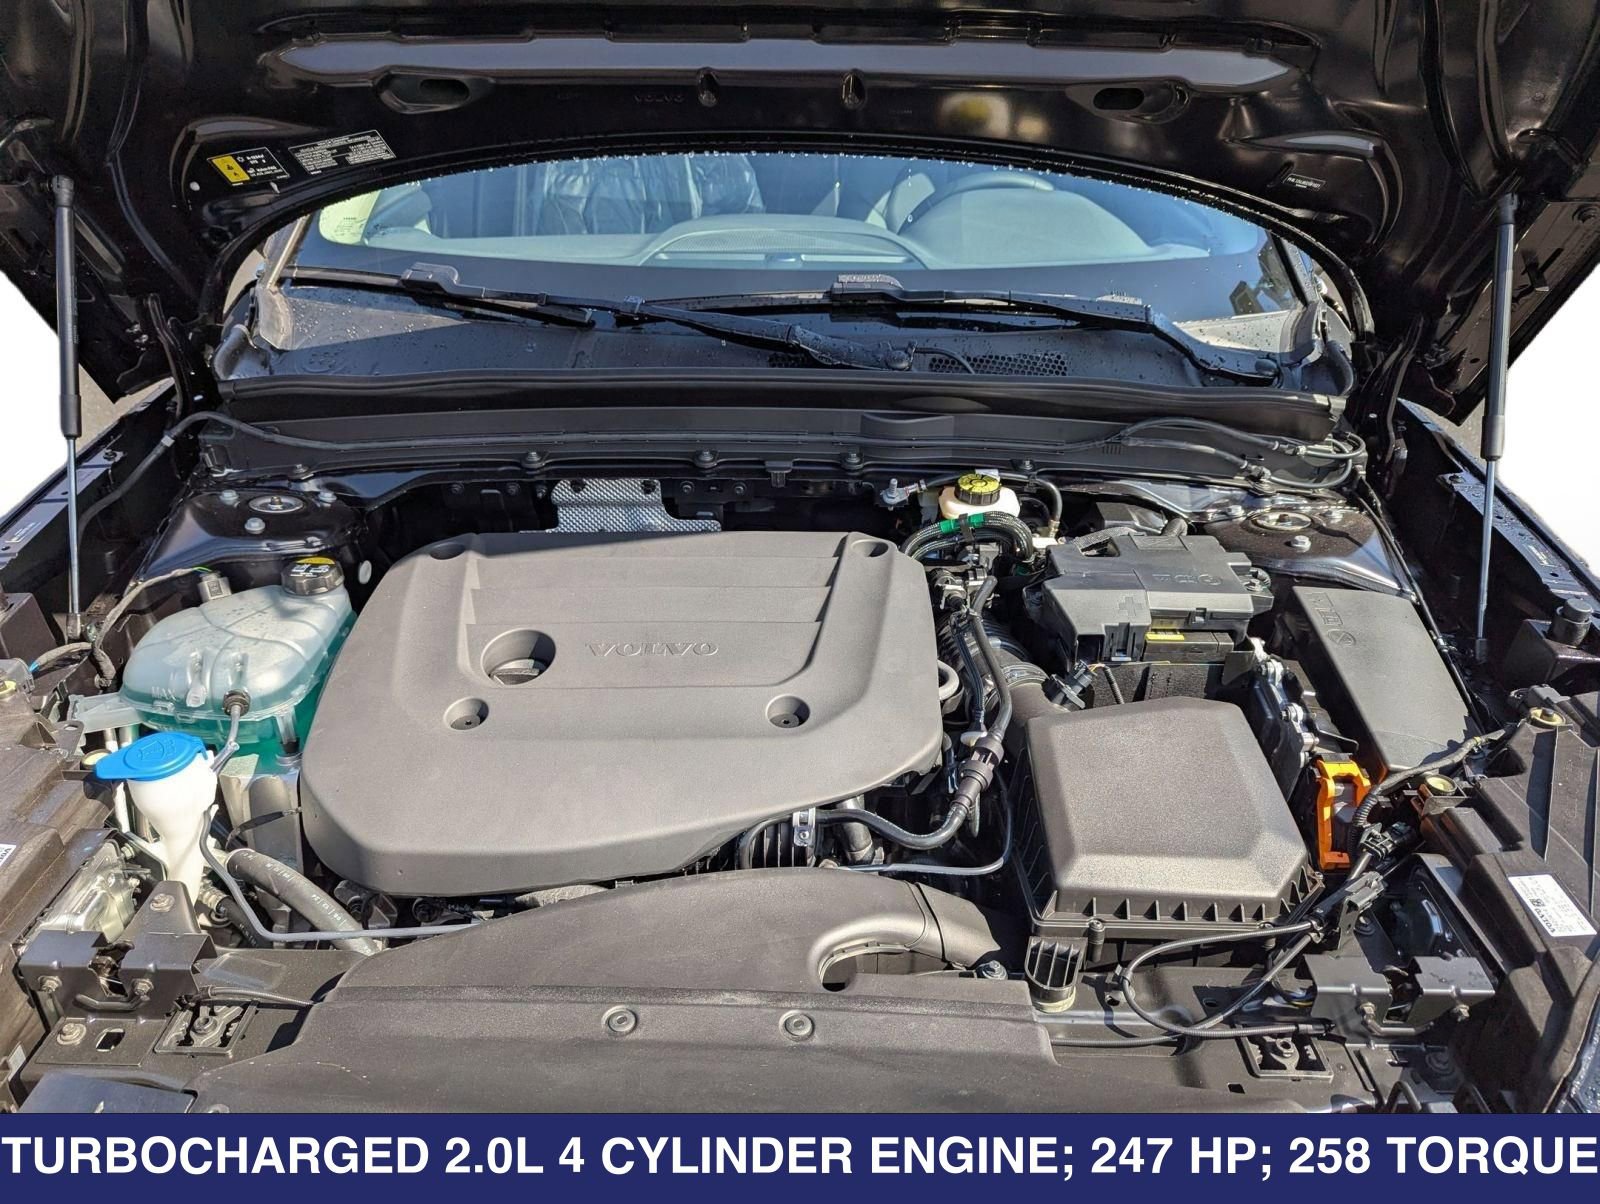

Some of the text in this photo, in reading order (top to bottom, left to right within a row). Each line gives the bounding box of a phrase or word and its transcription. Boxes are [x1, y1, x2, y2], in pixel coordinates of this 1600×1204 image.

[633, 95, 684, 103] VOLVO
[585, 641, 719, 658] VOLVO
[151, 686, 176, 701] MAX
[1535, 908, 1556, 933] VOLVO
